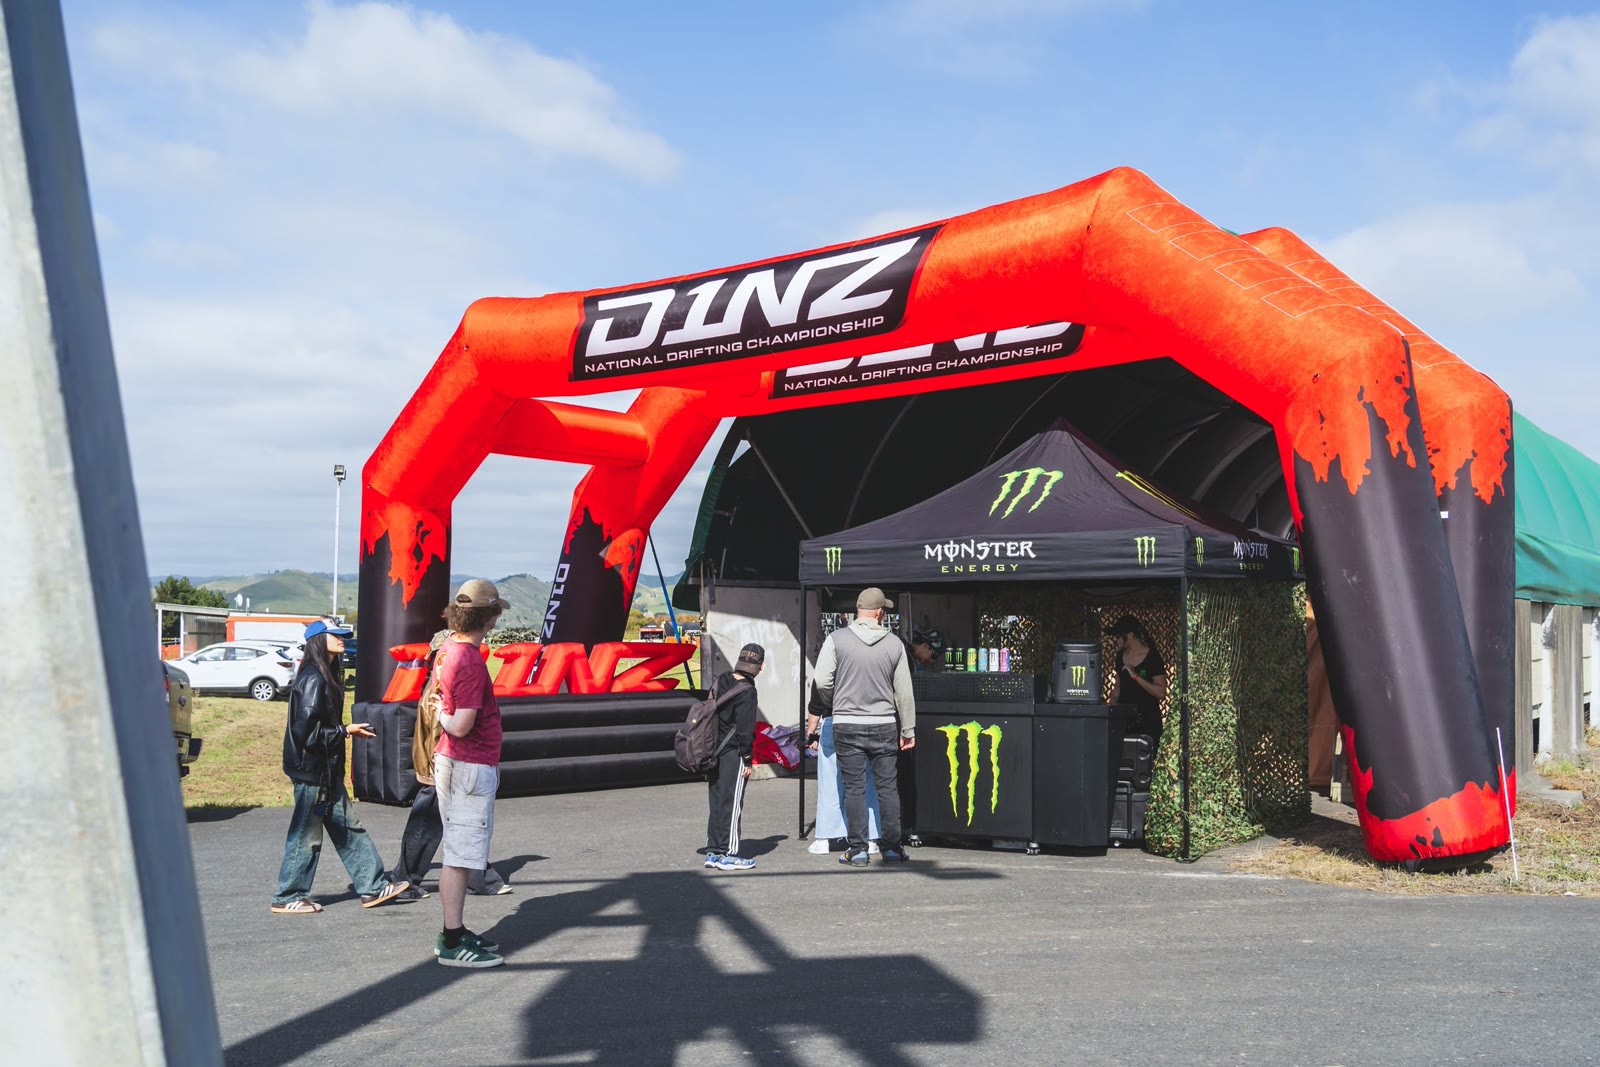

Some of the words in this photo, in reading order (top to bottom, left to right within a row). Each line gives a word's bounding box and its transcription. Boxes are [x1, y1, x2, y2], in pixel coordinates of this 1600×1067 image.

[585, 236, 921, 357] D1NZ
[584, 355, 663, 373] NATIONAL
[666, 342, 743, 362] DRIFTING
[746, 316, 884, 350] CHAMPIONSHIP
[784, 374, 859, 391] NATIONAL
[861, 363, 933, 381] DRIFTING
[936, 342, 1063, 370] CHAMPIONSHIP
[924, 538, 1037, 561] MONSTER
[1233, 538, 1269, 560] MONSTER
[941, 563, 1020, 574] ENERGY
